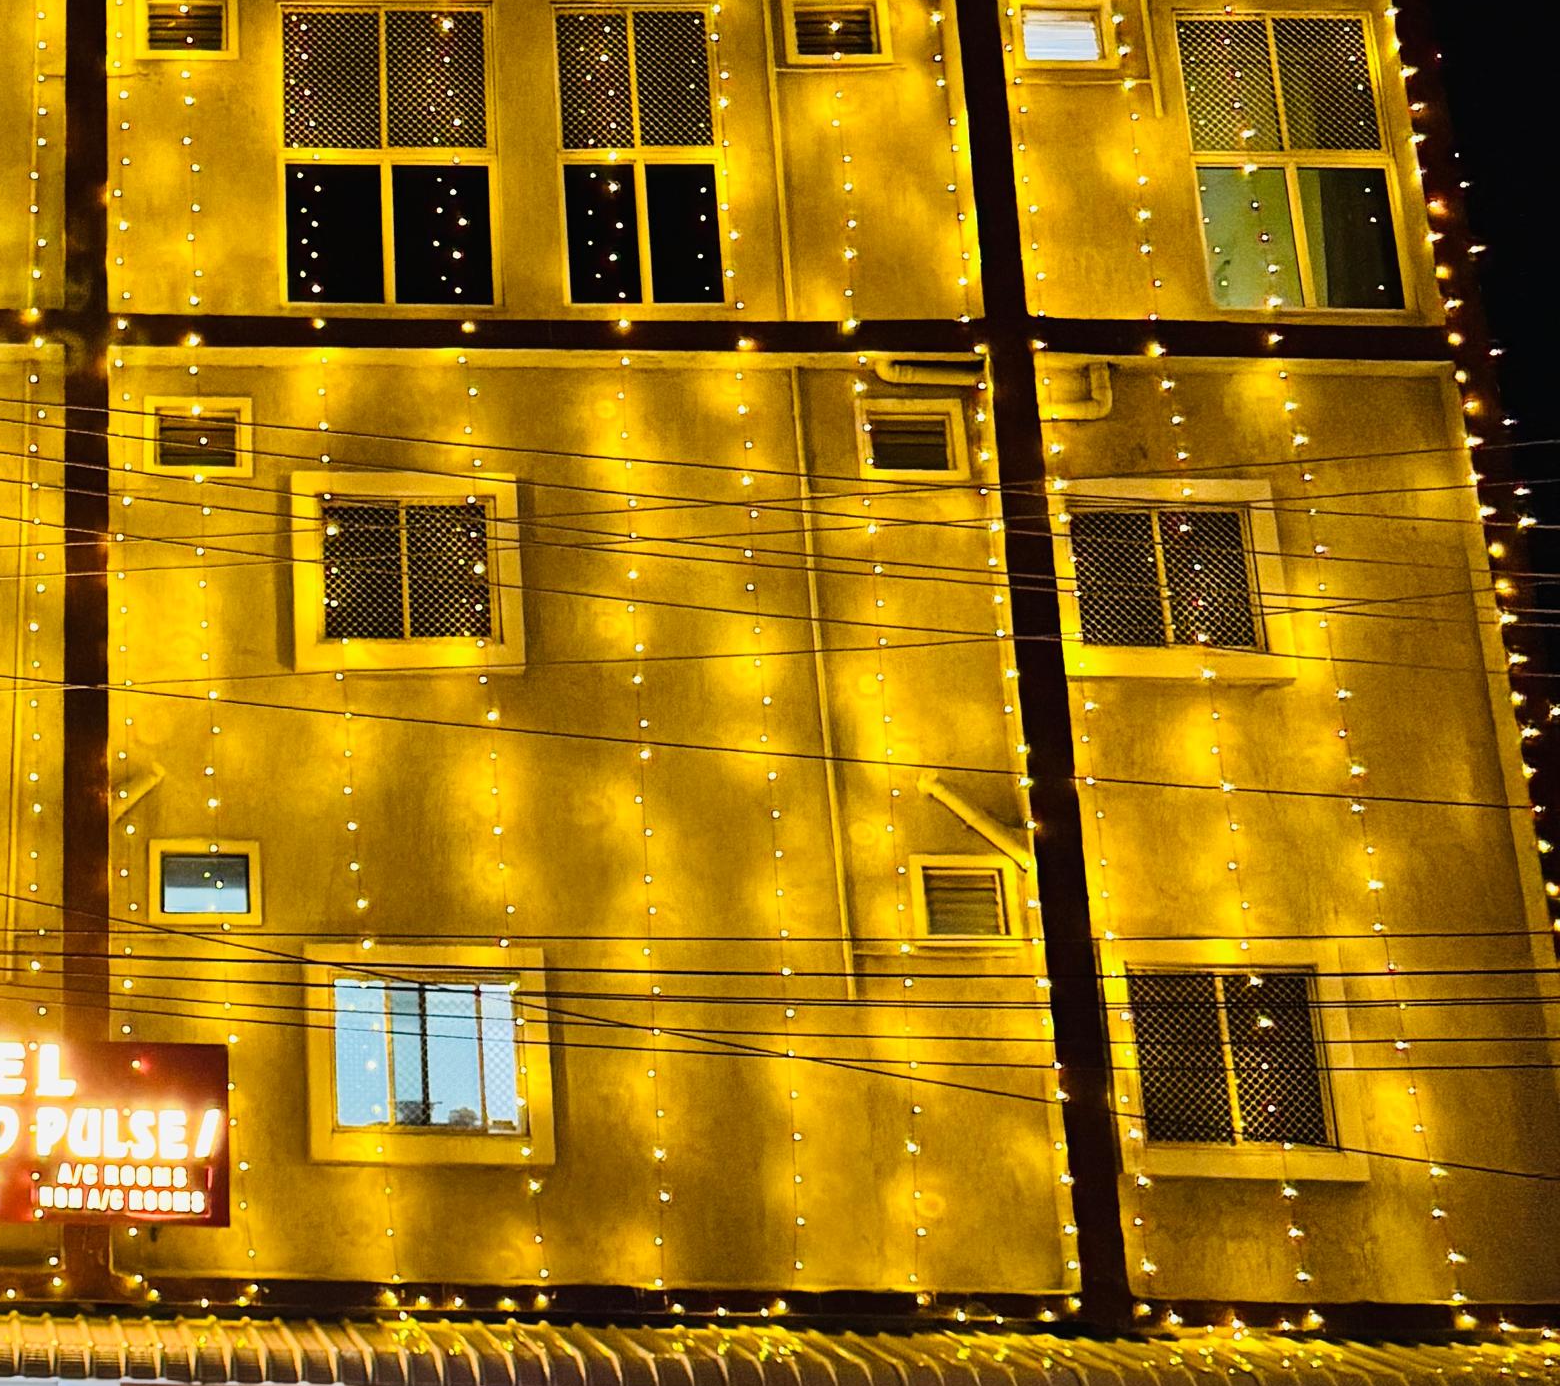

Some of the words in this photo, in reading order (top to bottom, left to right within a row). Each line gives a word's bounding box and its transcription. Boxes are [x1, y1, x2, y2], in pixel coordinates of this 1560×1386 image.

[57, 1162, 98, 1186] A/C
[103, 1164, 188, 1188] ROOMS
[39, 1186, 83, 1209] NON
[86, 1188, 124, 1211] A/C
[128, 1189, 205, 1213] ROOMS
